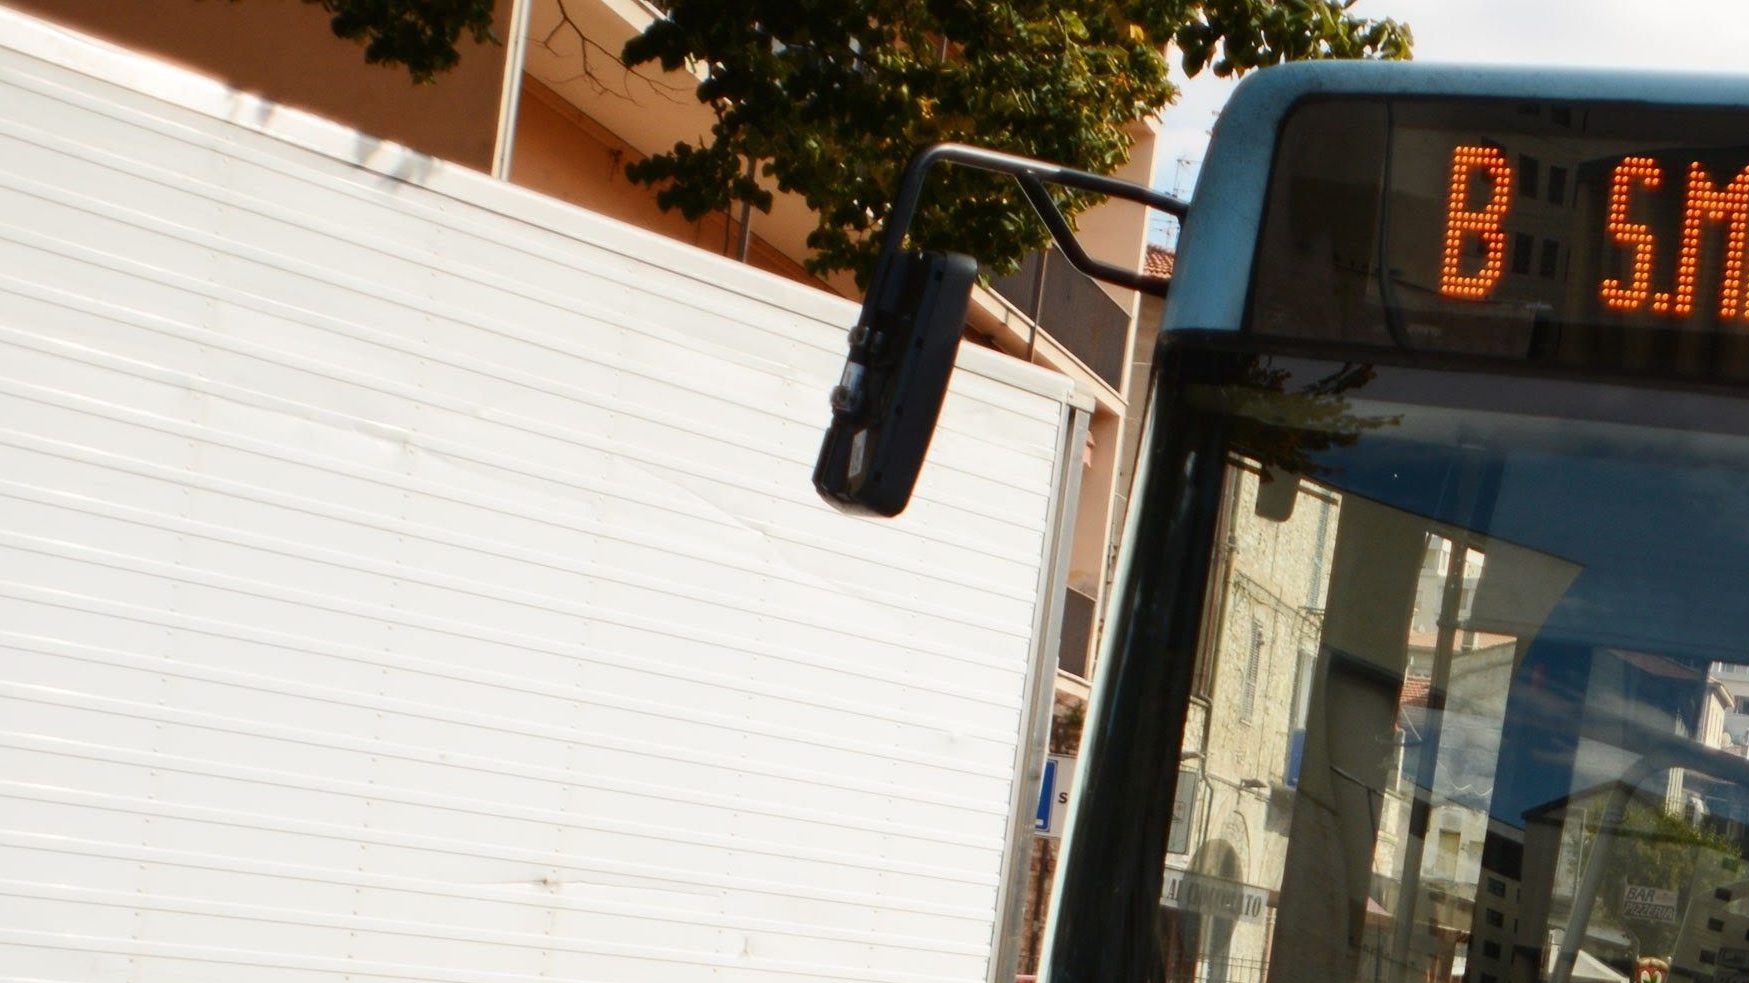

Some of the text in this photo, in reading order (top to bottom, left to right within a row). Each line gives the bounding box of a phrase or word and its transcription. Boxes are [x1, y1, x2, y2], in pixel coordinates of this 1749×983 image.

[1440, 145, 1511, 300] B
[1626, 887, 1656, 902] BAR
[1624, 901, 1674, 921] PIZZERIA
